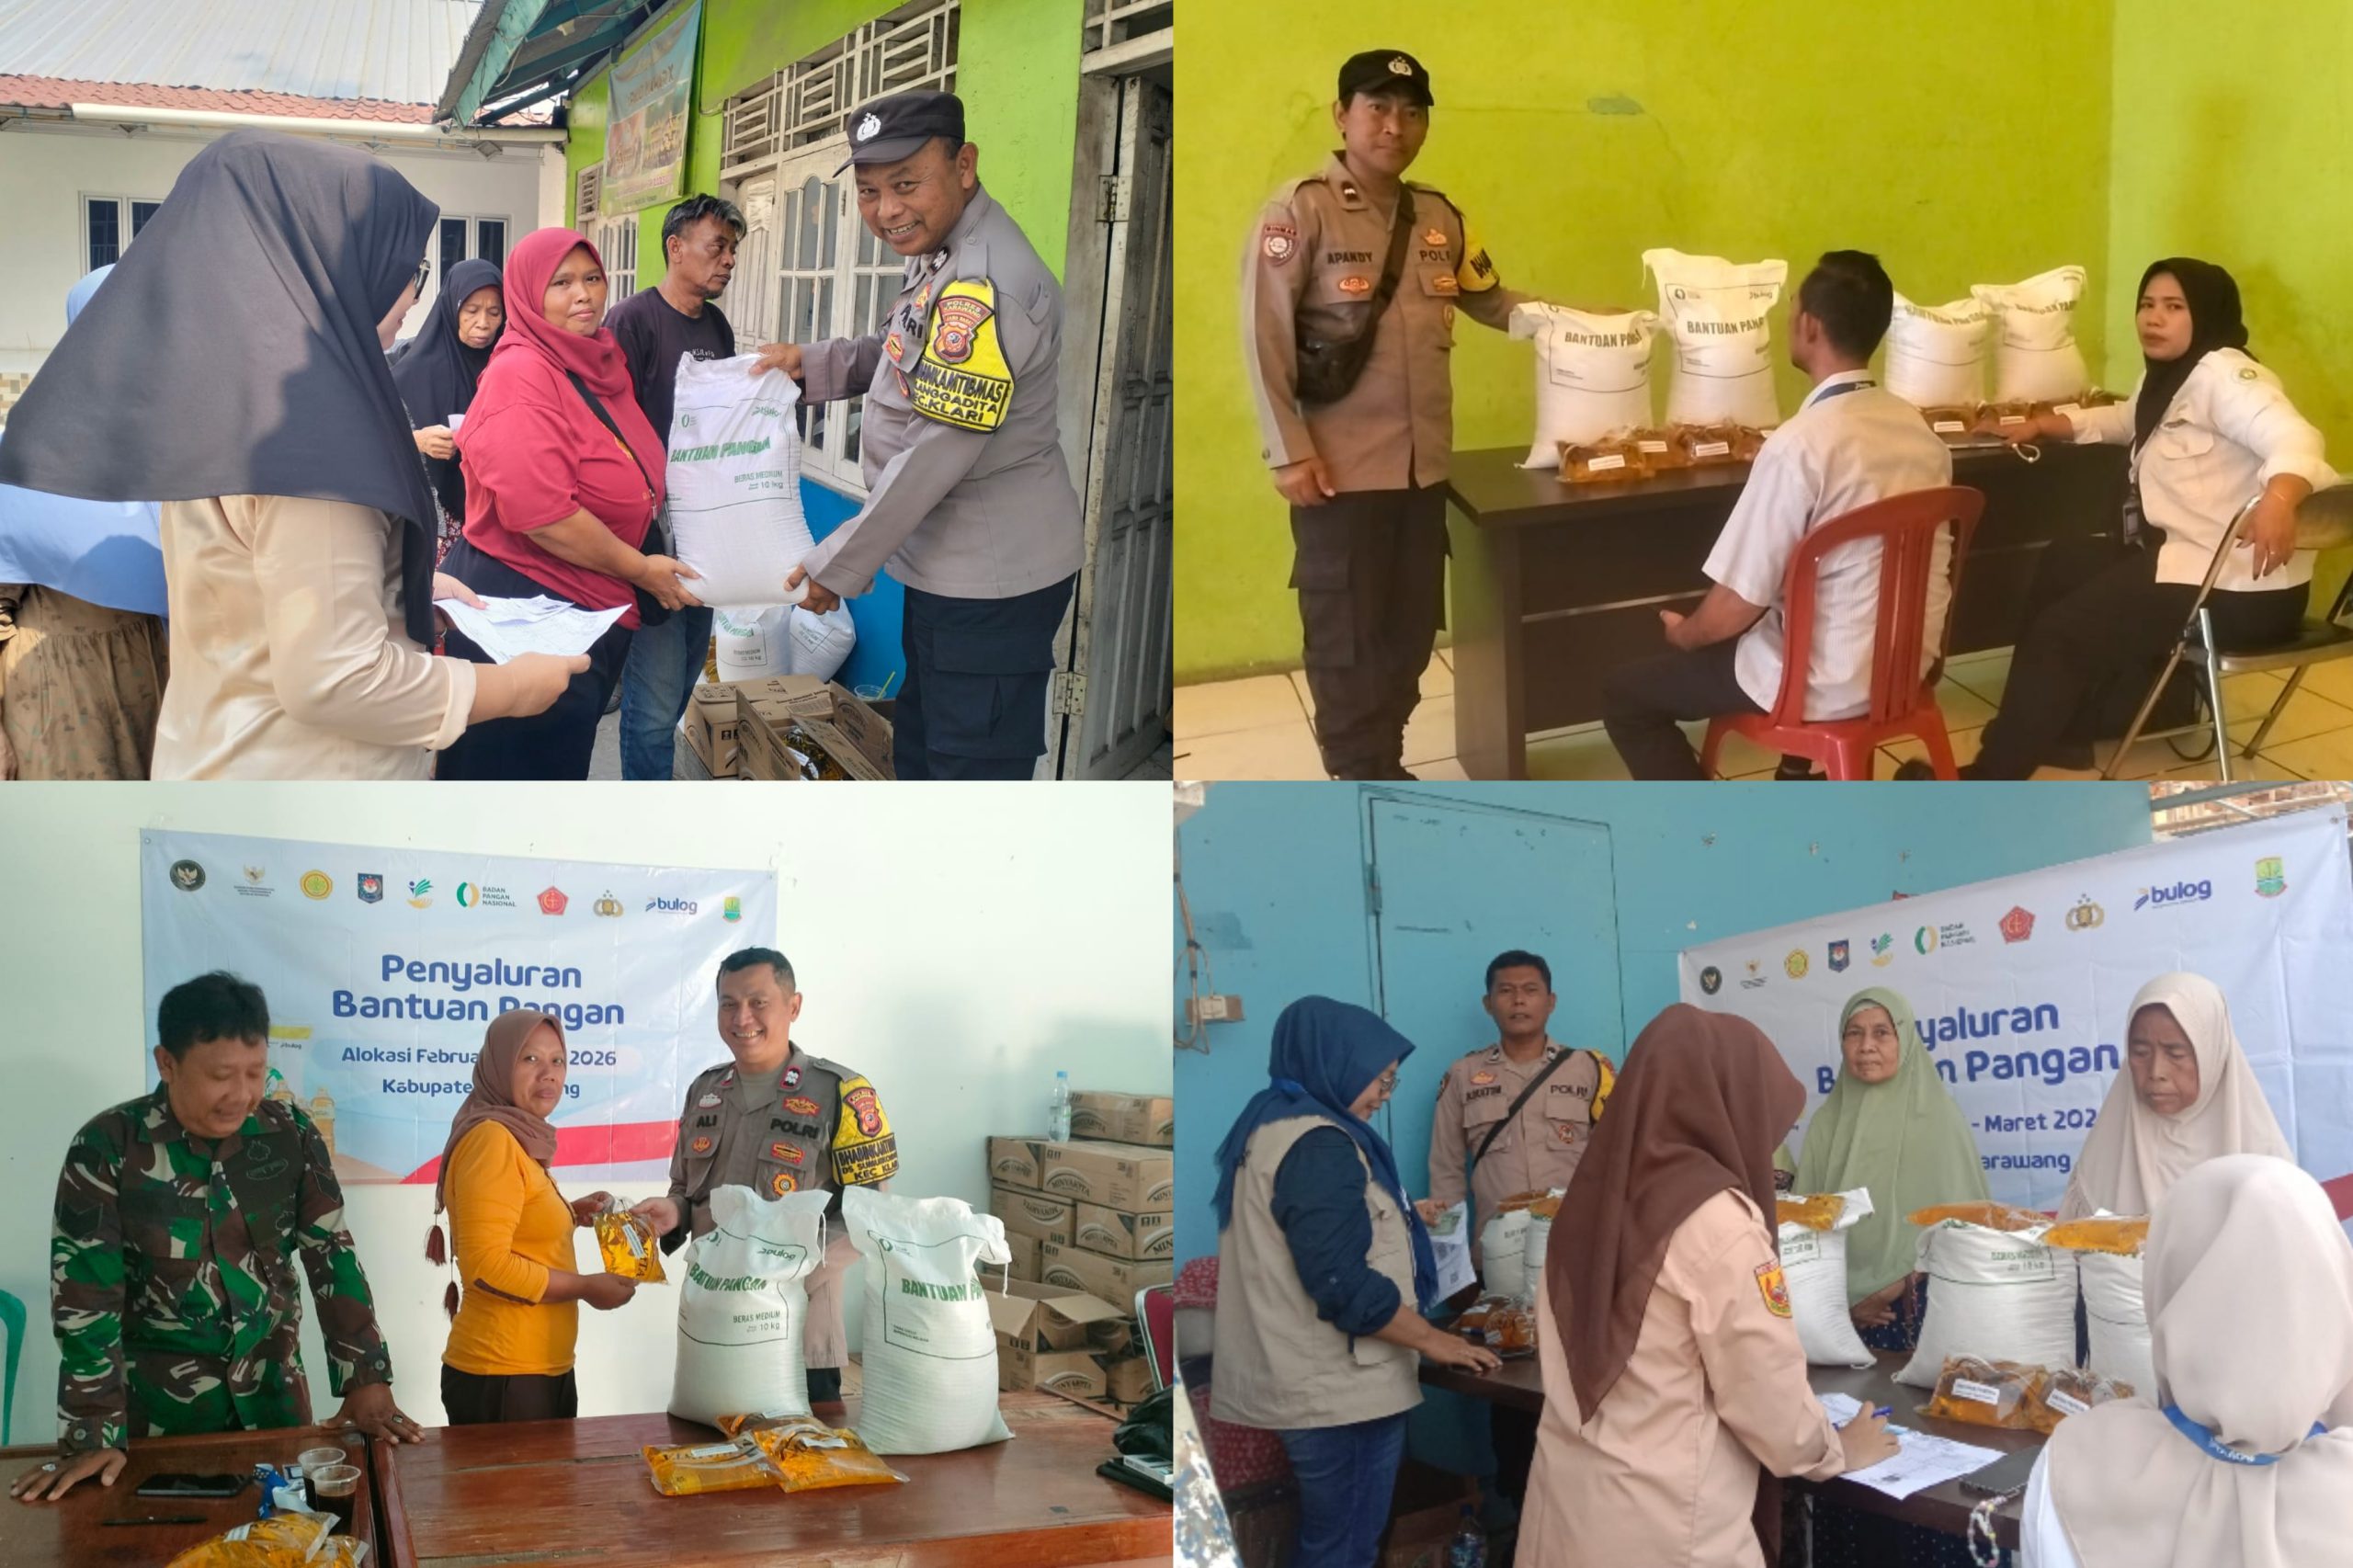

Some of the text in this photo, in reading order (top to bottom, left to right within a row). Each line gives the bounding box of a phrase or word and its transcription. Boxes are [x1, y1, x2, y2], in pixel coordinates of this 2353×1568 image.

[1327, 252, 1372, 265] APANDY
[1687, 321, 1739, 335] BANTUAN
[1564, 332, 1619, 348] BANTUAN
[2152, 880, 2211, 901] bulog
[483, 900, 517, 908] NASIONAL
[657, 897, 698, 915] bulog
[381, 954, 582, 992] Penyaluran
[332, 990, 488, 1021] Bantuan
[342, 1047, 412, 1062] Alokasi
[570, 1051, 617, 1066] 2026
[1966, 1043, 2120, 1086] Pangan
[382, 1079, 473, 1095] Kabupate
[1551, 1085, 1588, 1097] POLRI
[697, 1115, 717, 1129] ALI
[1985, 1112, 2048, 1133] Maret
[2053, 1108, 2097, 1131] 202
[770, 1118, 819, 1140] POLRI
[854, 1168, 877, 1181] KEC
[901, 1278, 968, 1301] BANTUAN
[733, 1311, 780, 1324] BERAS MEDIUM
[760, 1323, 769, 1331] 10
